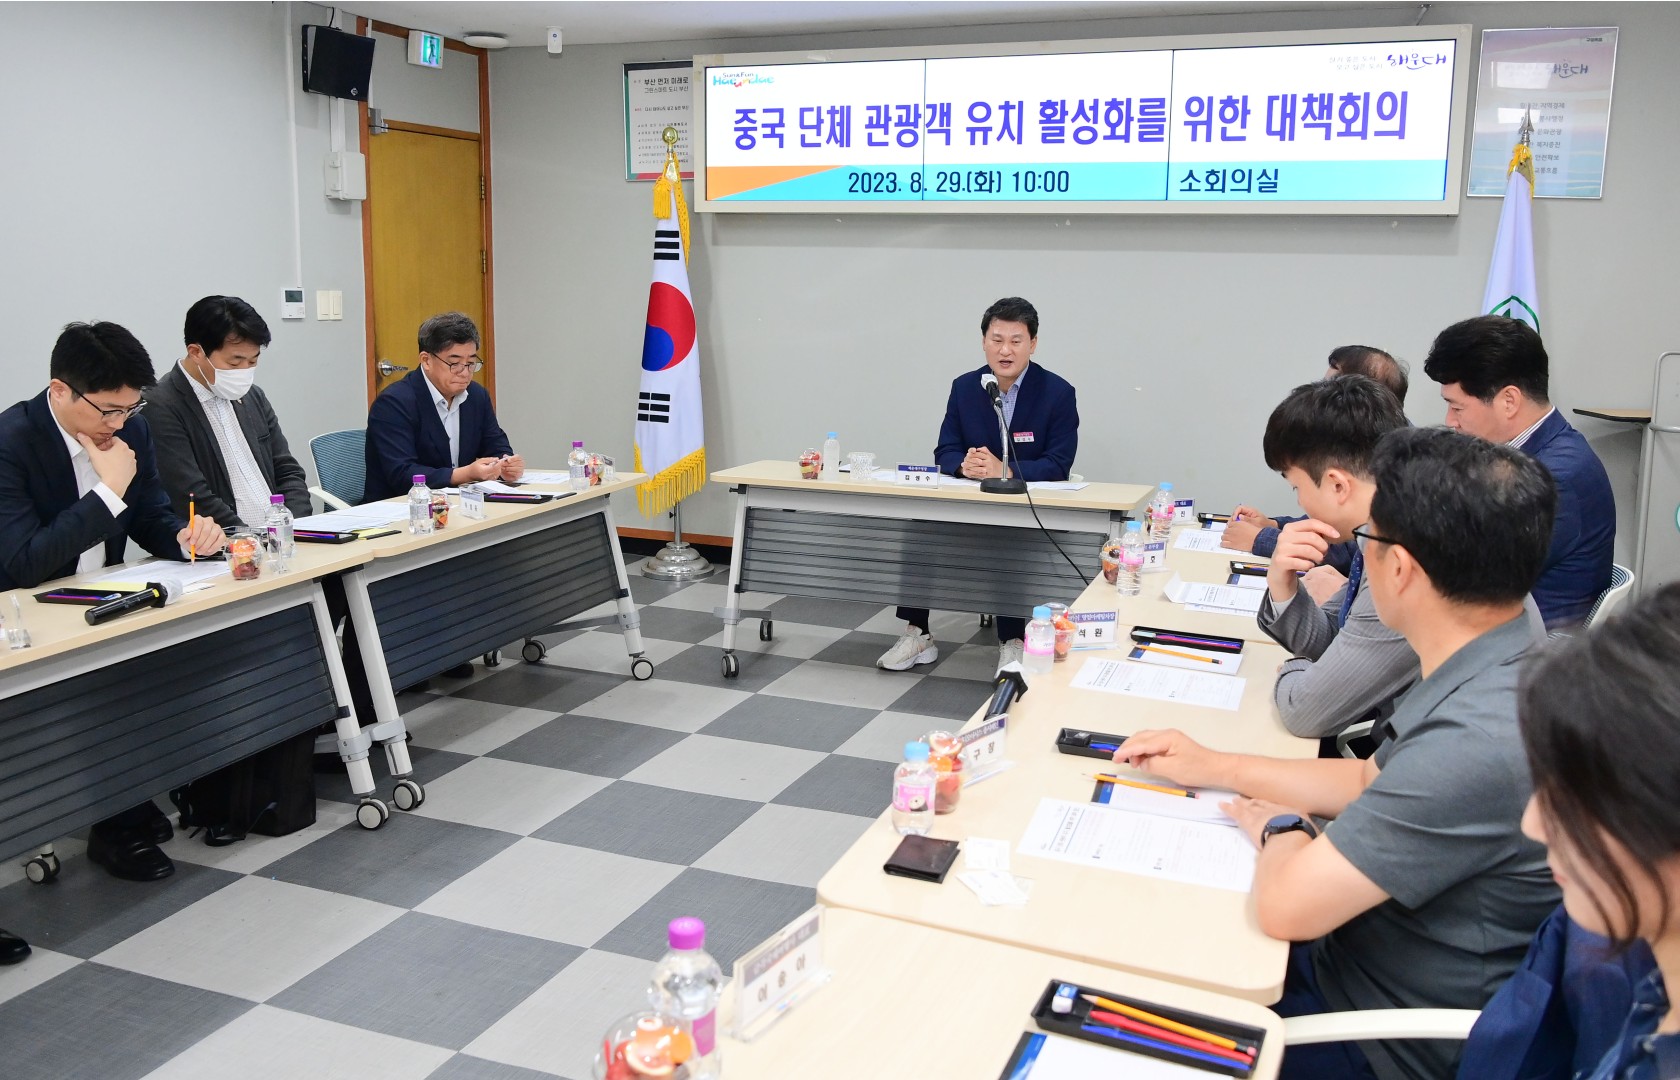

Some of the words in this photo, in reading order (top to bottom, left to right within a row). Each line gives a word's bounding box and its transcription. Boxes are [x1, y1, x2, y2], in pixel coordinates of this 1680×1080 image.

[1387, 52, 1447, 70] 해운대
[644, 78, 656, 86] 부산
[657, 78, 669, 86] 먼저
[671, 76, 689, 85] 미래로
[712, 74, 775, 88] Haeundae
[733, 107, 786, 150] 중국
[799, 105, 852, 148] 단체
[864, 102, 952, 148] 관광객
[965, 100, 1024, 146] 유치
[1038, 97, 1167, 146] 활성화를
[1183, 94, 1251, 143] 위한
[1265, 91, 1408, 141] 대책회의
[848, 171, 902, 194] 2023.
[910, 171, 928, 193] 8.
[936, 170, 1002, 194] 29.(화)
[1012, 170, 1070, 193] 10:00
[1179, 168, 1279, 194] 소회의실
